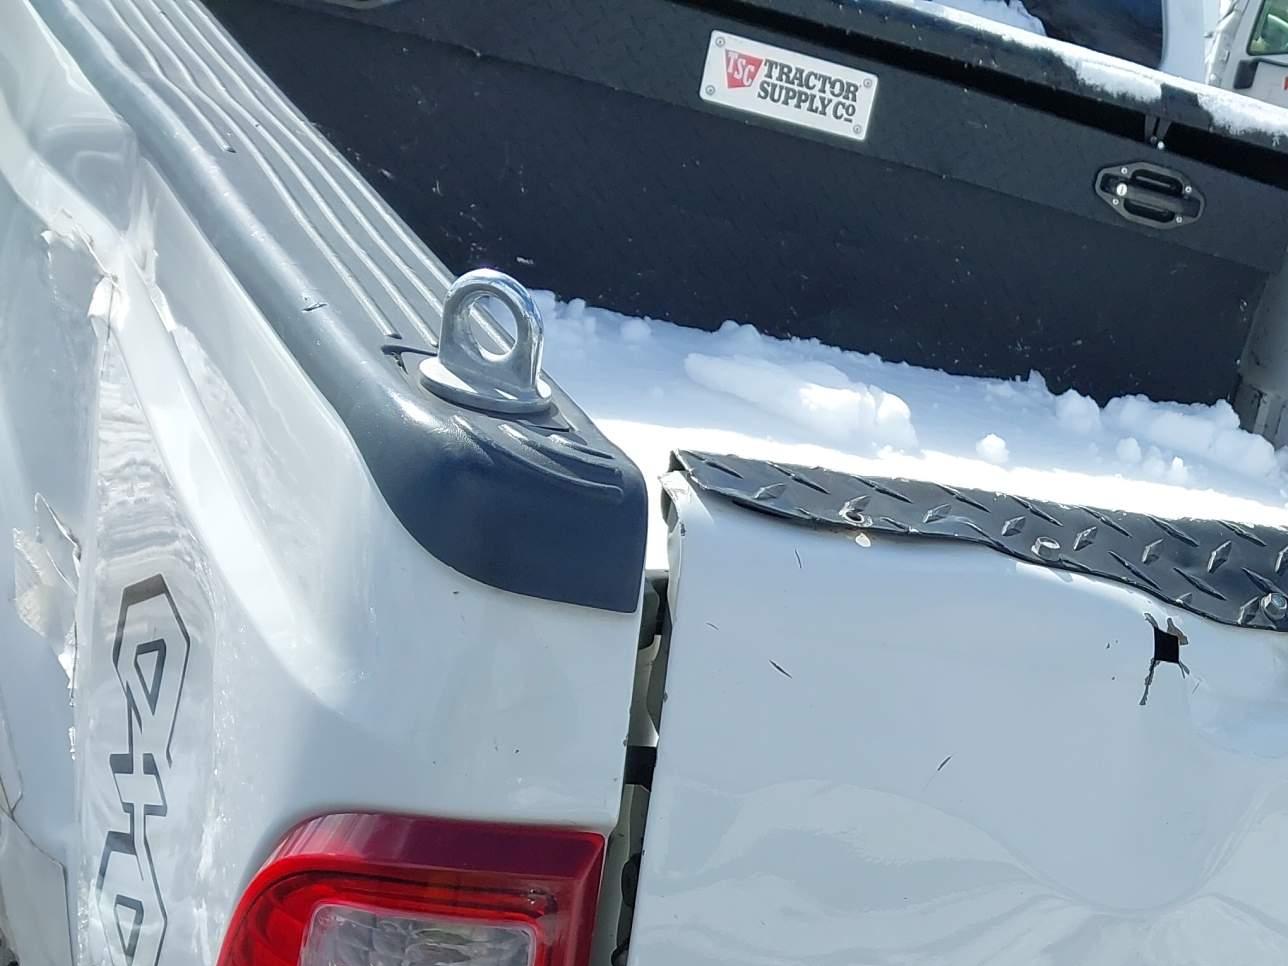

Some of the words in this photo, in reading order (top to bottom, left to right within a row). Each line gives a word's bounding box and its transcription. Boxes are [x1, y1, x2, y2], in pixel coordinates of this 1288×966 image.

[725, 51, 755, 88] TSC
[762, 58, 859, 103] TRACTOR
[757, 80, 833, 118] SUPPLY
